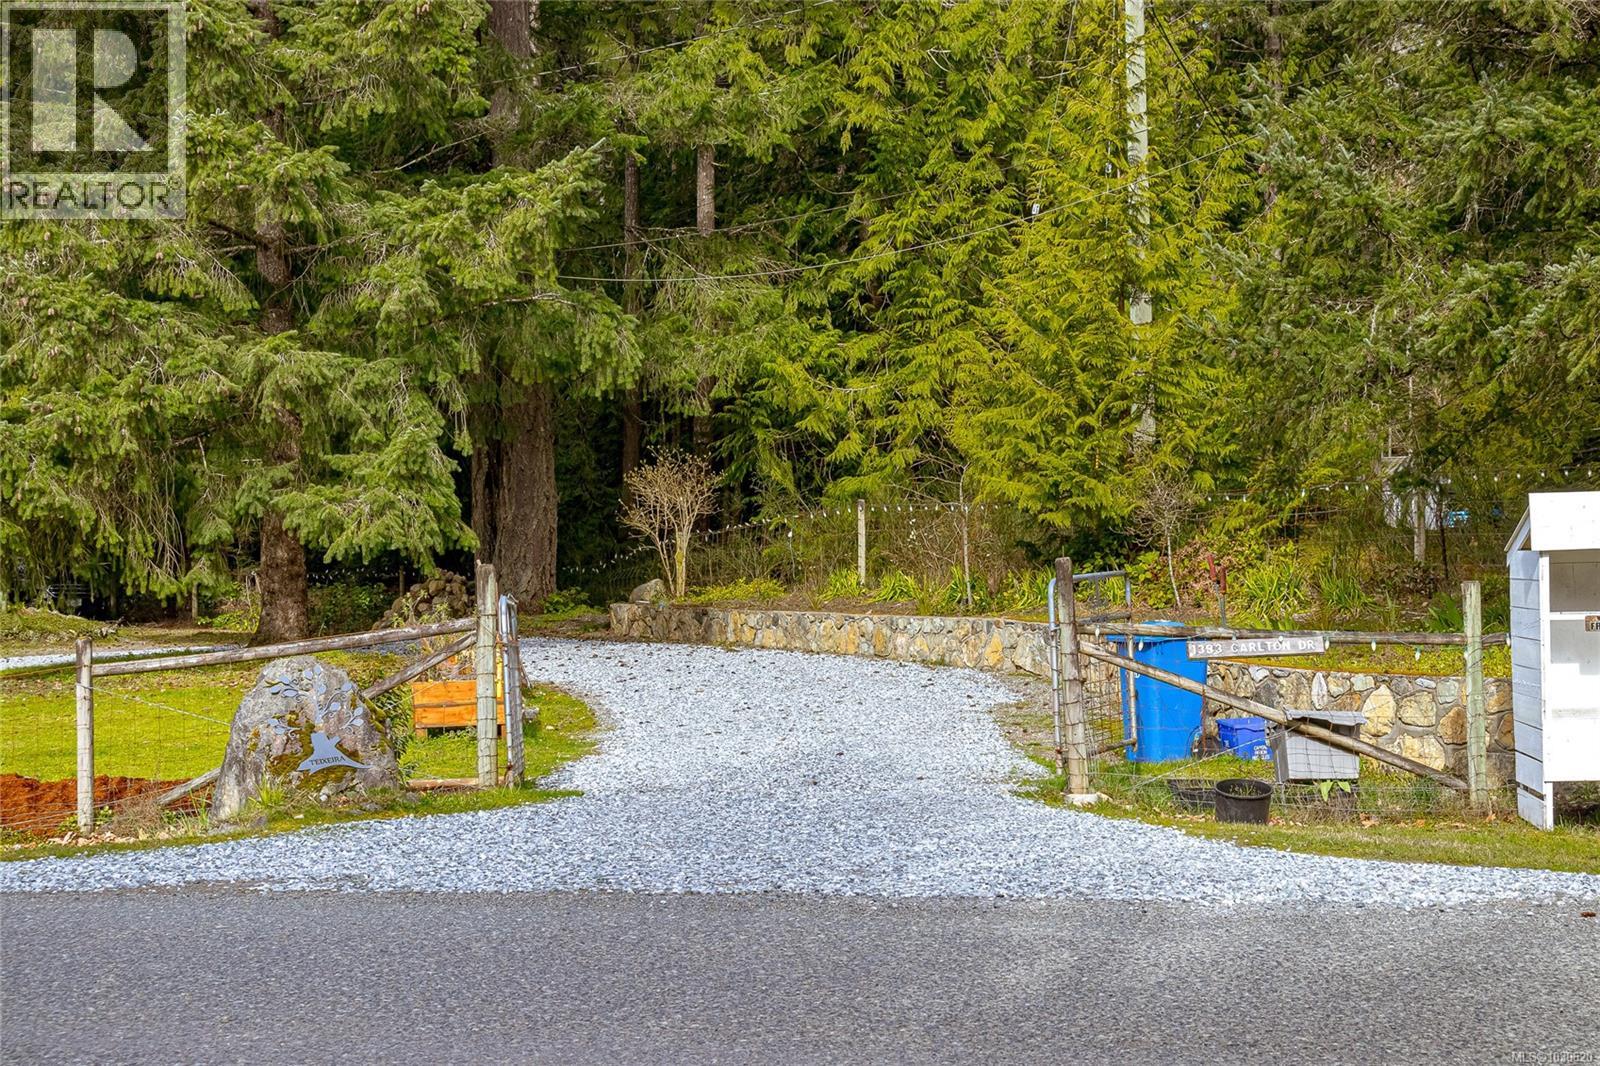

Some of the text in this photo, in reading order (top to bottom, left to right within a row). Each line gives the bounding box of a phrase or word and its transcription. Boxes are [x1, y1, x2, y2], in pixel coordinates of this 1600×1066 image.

[1231, 641, 1291, 653] CARLTON
[1298, 639, 1316, 650] DR
[310, 755, 346, 766] TEIXEIRA
